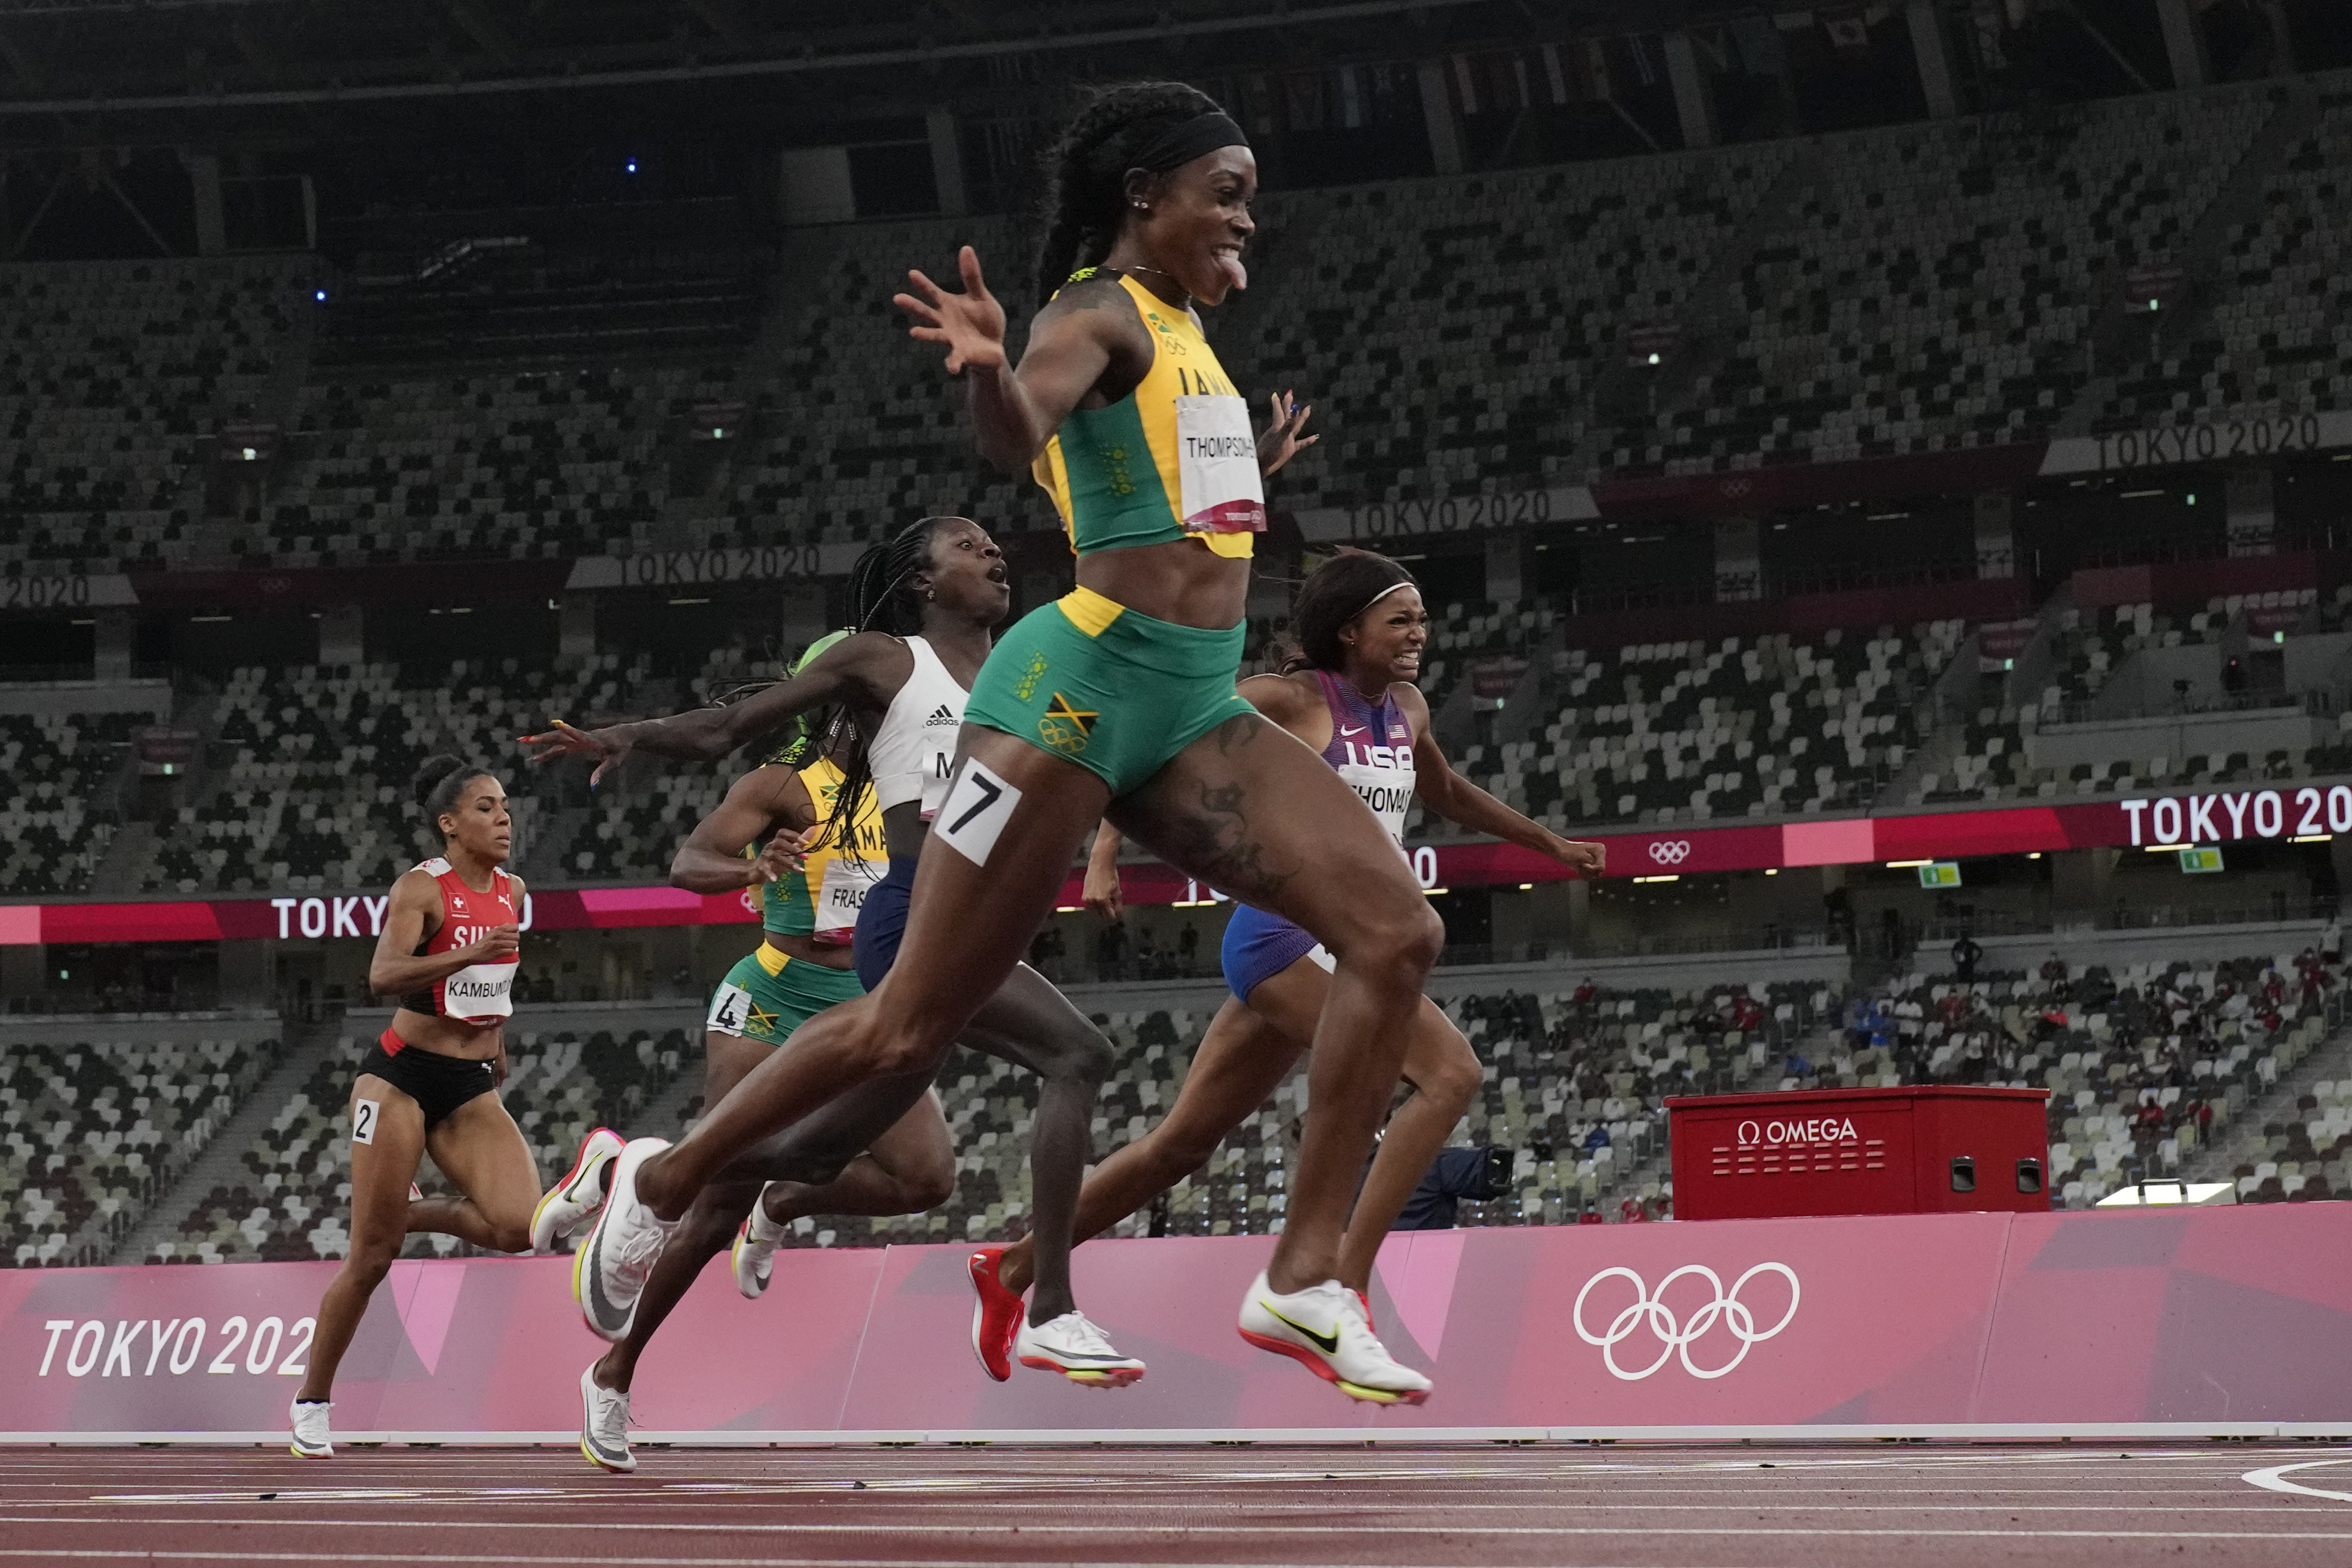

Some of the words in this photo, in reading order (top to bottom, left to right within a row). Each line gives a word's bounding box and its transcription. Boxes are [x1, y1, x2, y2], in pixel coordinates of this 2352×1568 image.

[2094, 424, 2216, 470] TOKYO
[2227, 413, 2320, 454] 2020
[1344, 499, 1459, 538] TOKYO
[1467, 491, 1551, 526] 2020
[617, 549, 729, 586] TOKYO
[740, 543, 820, 579] 2020
[6, 575, 90, 608] 2020
[926, 717, 959, 726] adidas
[1344, 741, 1414, 771] USA
[947, 772, 1003, 835] 7
[1352, 785, 1411, 813] HOMAS
[2121, 790, 2283, 847] TOKYO
[832, 888, 865, 909] FRAS
[271, 895, 389, 939] TOKY
[716, 992, 737, 1028] 4
[356, 1104, 371, 1139] 2
[1766, 1117, 1858, 1144] OMEGA
[39, 1317, 206, 1377] TOKYO
[207, 1315, 317, 1376] 202
